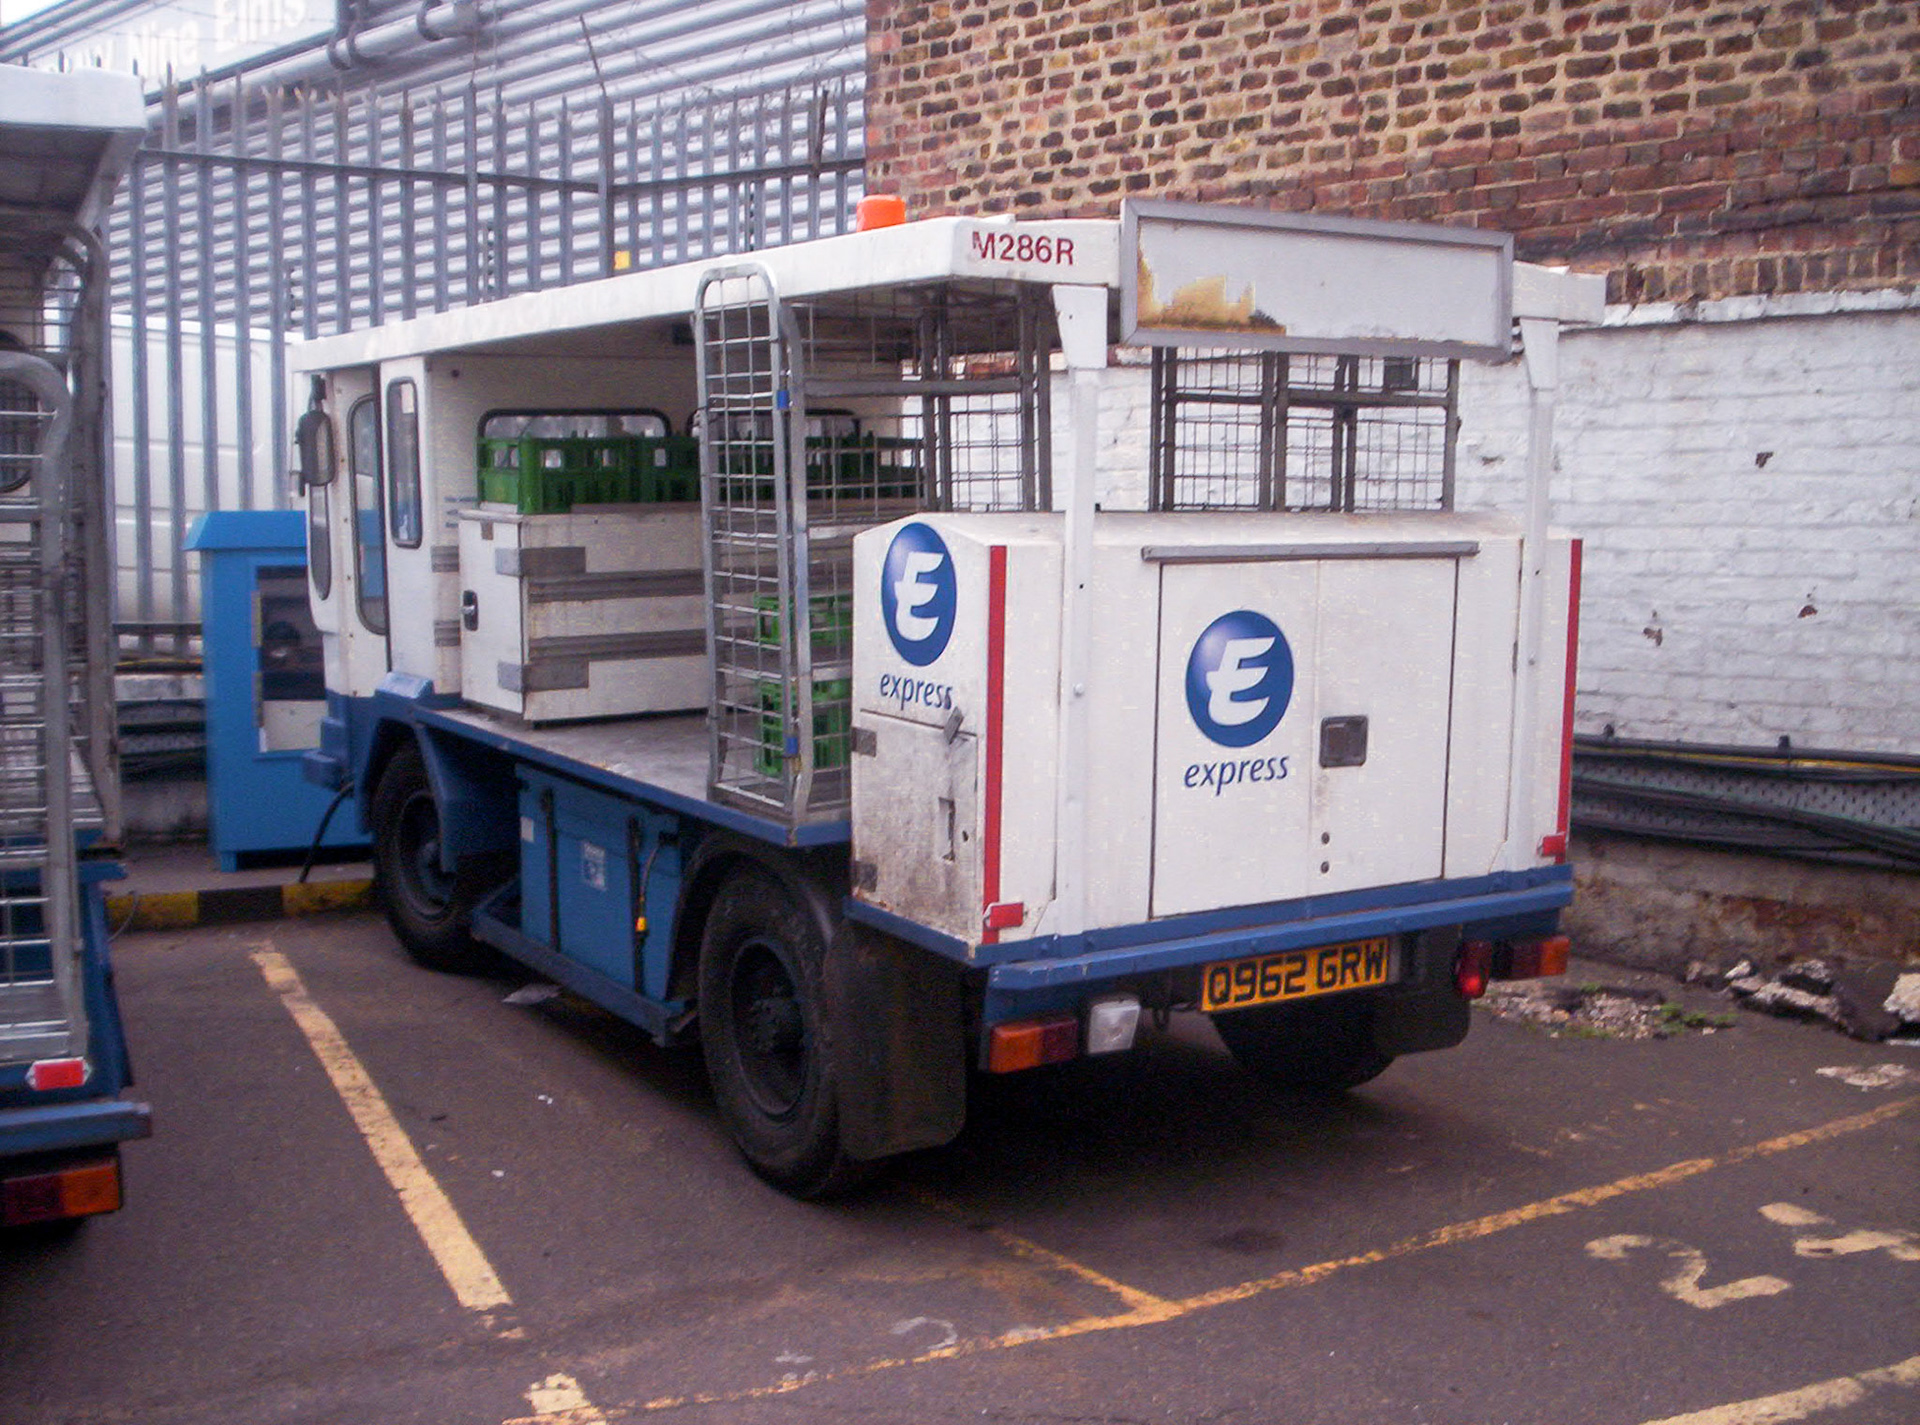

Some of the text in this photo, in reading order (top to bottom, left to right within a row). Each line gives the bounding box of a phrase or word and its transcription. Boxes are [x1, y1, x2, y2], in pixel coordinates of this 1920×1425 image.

[972, 230, 1075, 266] M286R
[879, 673, 954, 711] express
[1183, 756, 1290, 797] express
[1316, 942, 1386, 989] GRW
